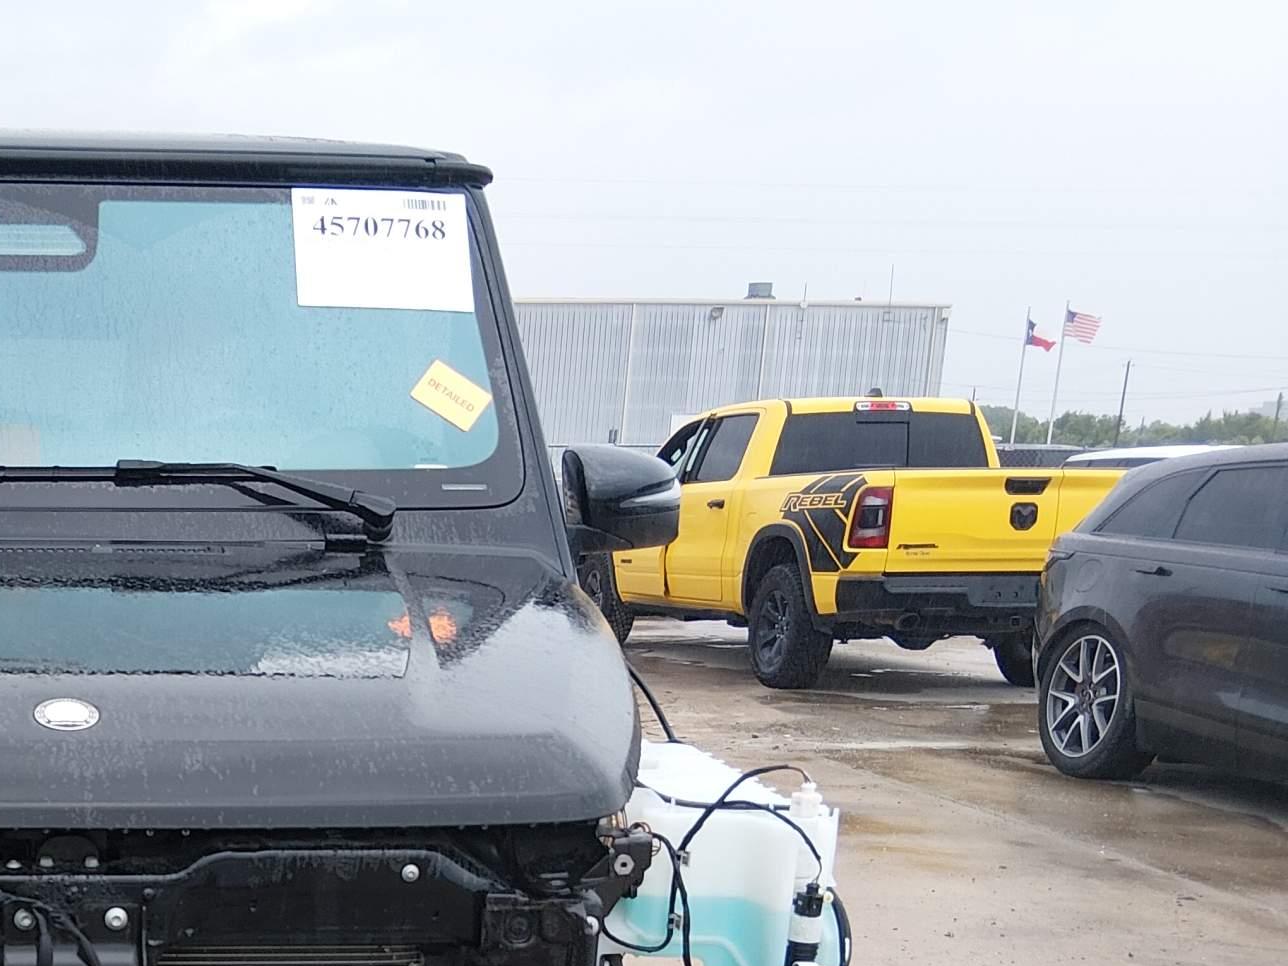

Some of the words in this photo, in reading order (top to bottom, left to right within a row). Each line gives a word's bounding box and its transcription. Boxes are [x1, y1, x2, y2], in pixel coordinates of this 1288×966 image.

[312, 215, 446, 240] 45707768
[427, 378, 475, 412] DETAILED
[779, 492, 847, 512] REBEL
